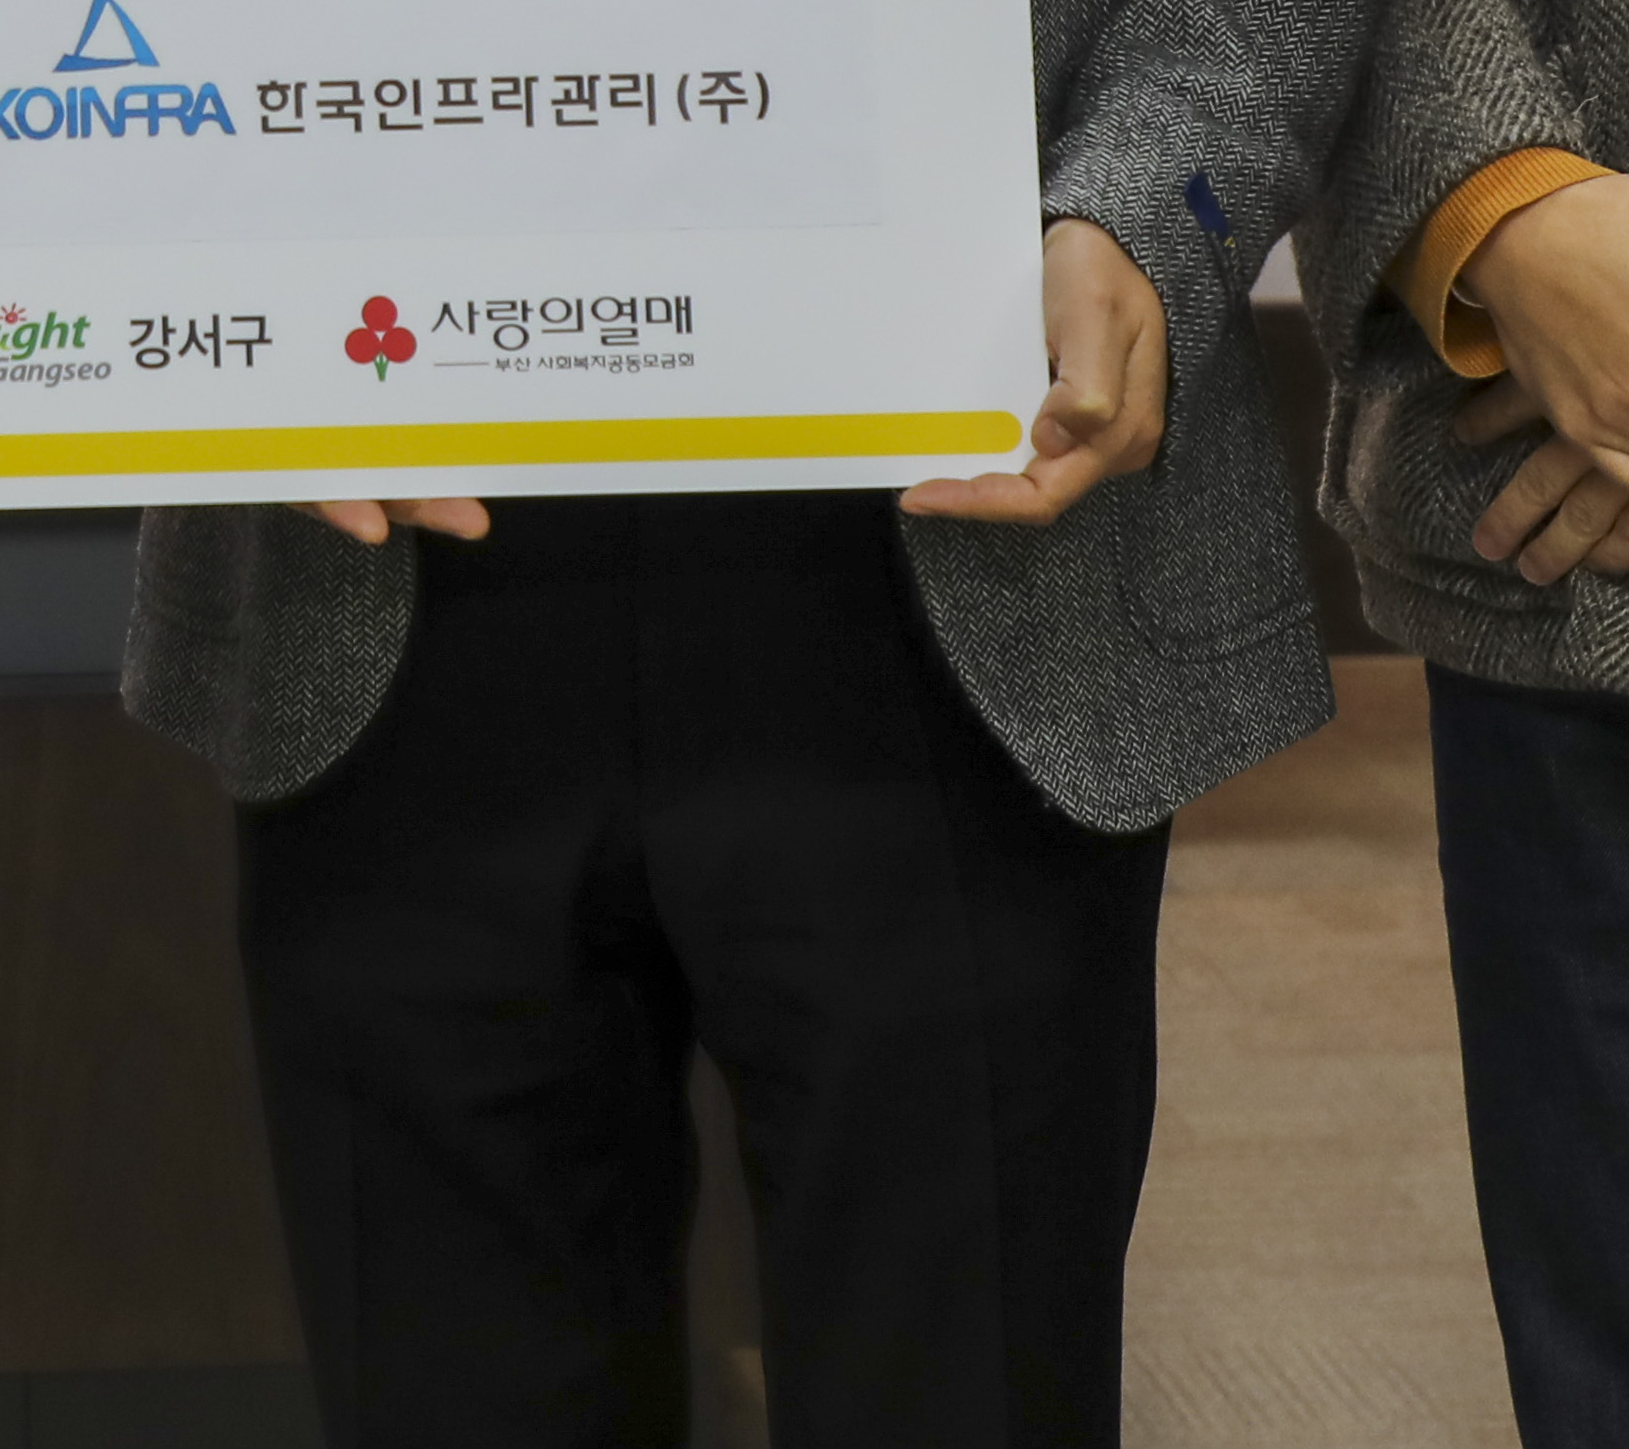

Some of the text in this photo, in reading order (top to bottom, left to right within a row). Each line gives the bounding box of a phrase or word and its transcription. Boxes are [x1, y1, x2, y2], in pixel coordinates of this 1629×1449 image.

[129, 314, 274, 371] 강서구
[431, 295, 694, 352] 사랑의열매
[494, 358, 533, 373] 부산
